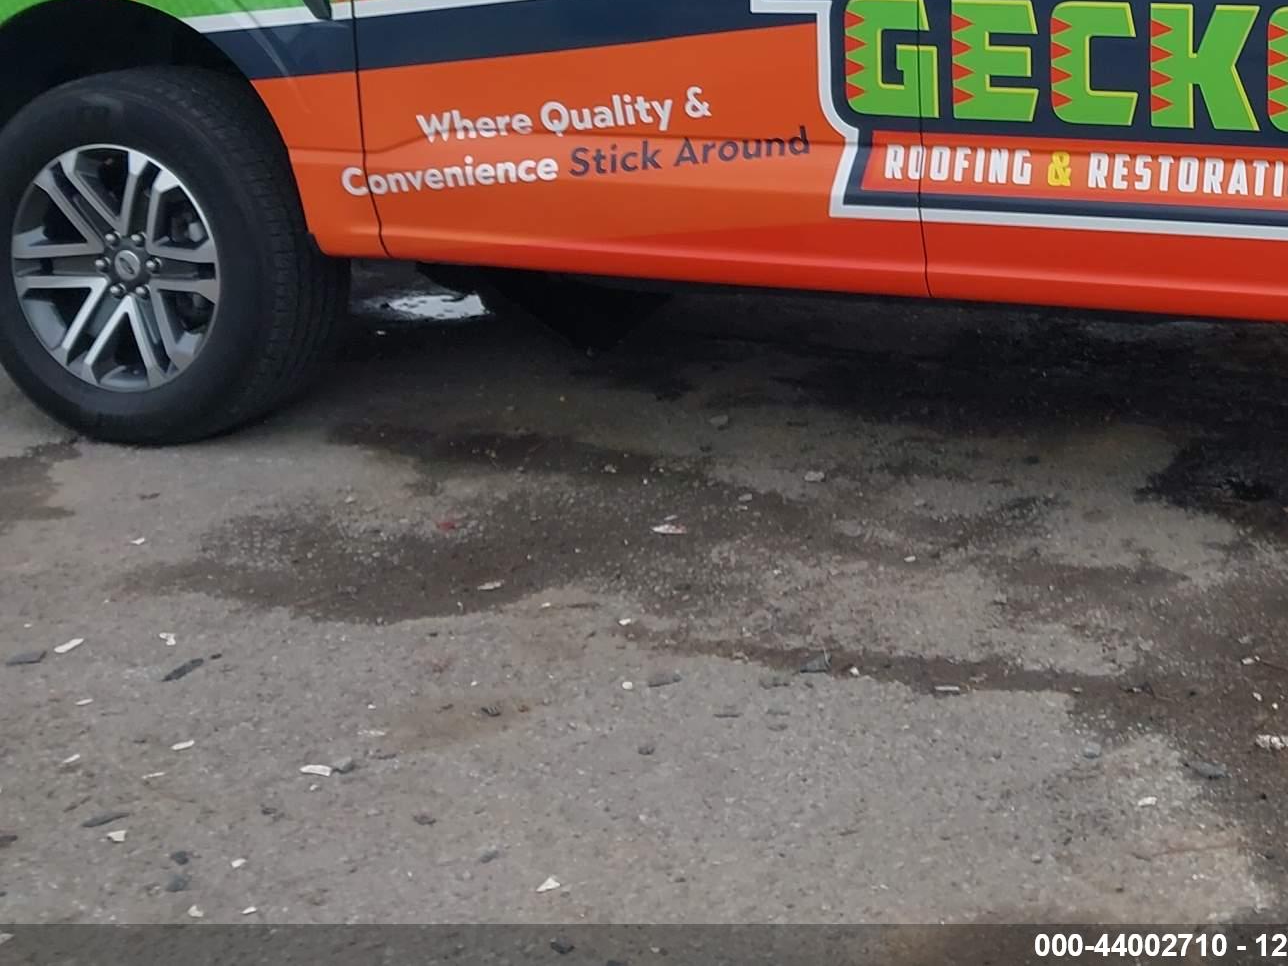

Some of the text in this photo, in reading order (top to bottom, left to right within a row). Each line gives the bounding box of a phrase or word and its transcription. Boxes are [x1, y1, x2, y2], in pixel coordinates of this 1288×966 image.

[415, 86, 712, 143] Where Quality &
[341, 125, 811, 198] Convenience Stick Around
[884, 144, 1032, 185] ROOFING
[1046, 150, 1072, 187] &
